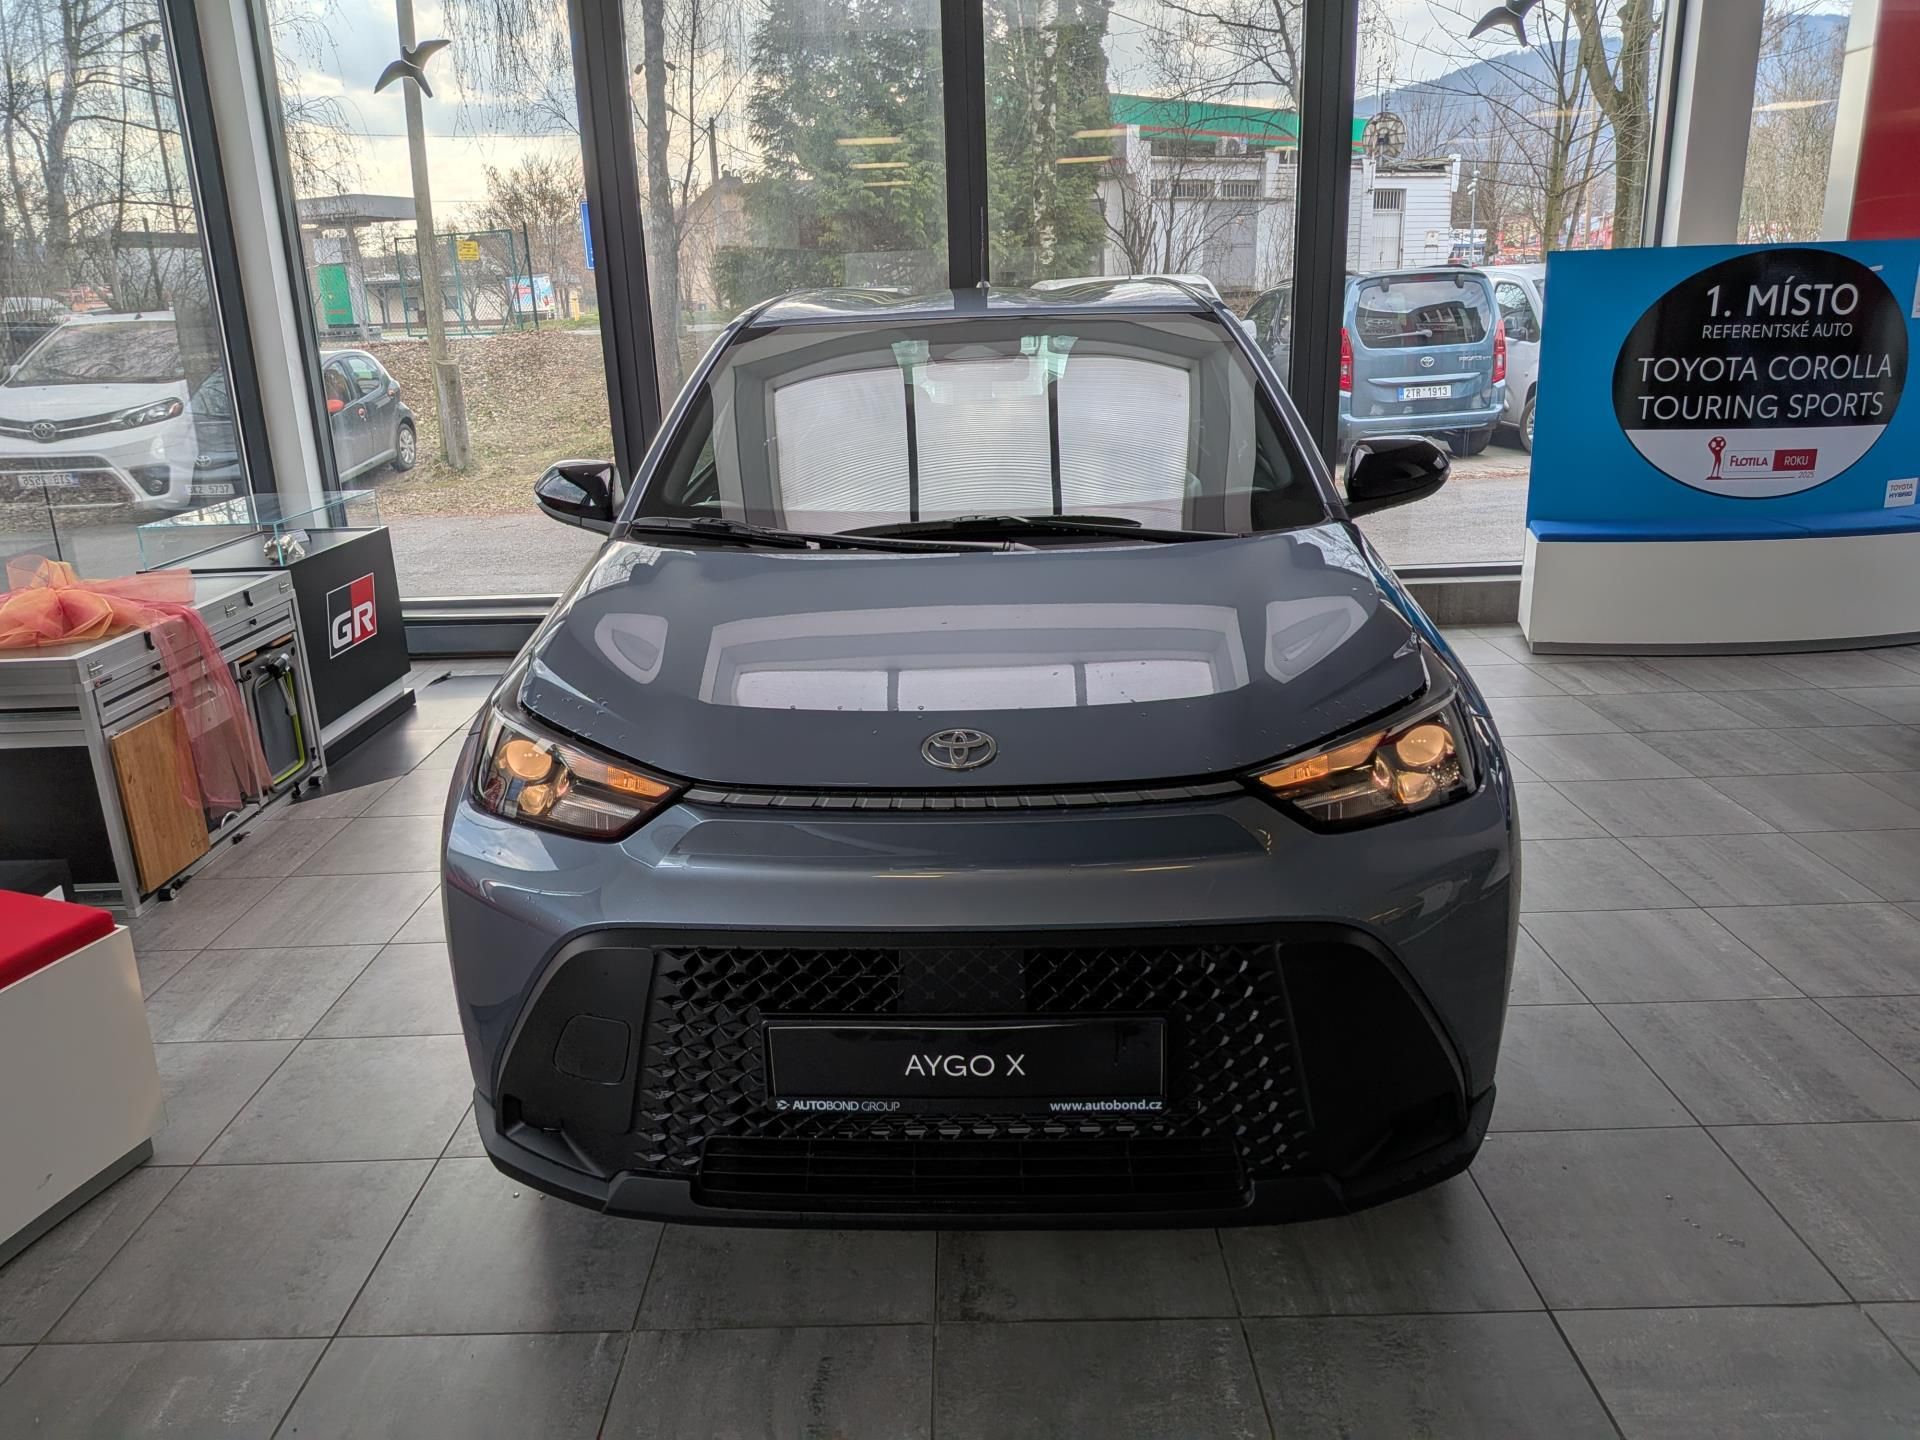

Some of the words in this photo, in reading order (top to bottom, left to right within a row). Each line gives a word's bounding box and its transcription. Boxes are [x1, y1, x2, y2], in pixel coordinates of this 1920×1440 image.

[1705, 284, 1731, 317] 1.
[1746, 275, 1859, 317] MÍSTO
[1701, 320, 1809, 339] REFERENTSKÉ
[1812, 322, 1853, 337] AUTO
[1638, 356, 1758, 382] TOYOTA
[1768, 353, 1892, 381] COROLLA
[1405, 388, 1421, 398] 2TR
[1427, 386, 1448, 397] 1913
[1638, 394, 1778, 420] TOURING
[1787, 391, 1884, 418] SPORTS
[1729, 455, 1768, 467] FLOTILA
[1784, 455, 1809, 466] ROKU
[1798, 471, 1815, 479] 2025
[208, 484, 229, 494] 5737
[1890, 483, 1913, 491] TOYOTA
[332, 600, 374, 649] GR
[904, 1054, 995, 1077] AYGO
[1005, 1053, 1026, 1077] X
[792, 1100, 859, 1111] AUTOBOND
[861, 1101, 900, 1112] GROUP
[1049, 1099, 1162, 1112] www.autobond.cz
